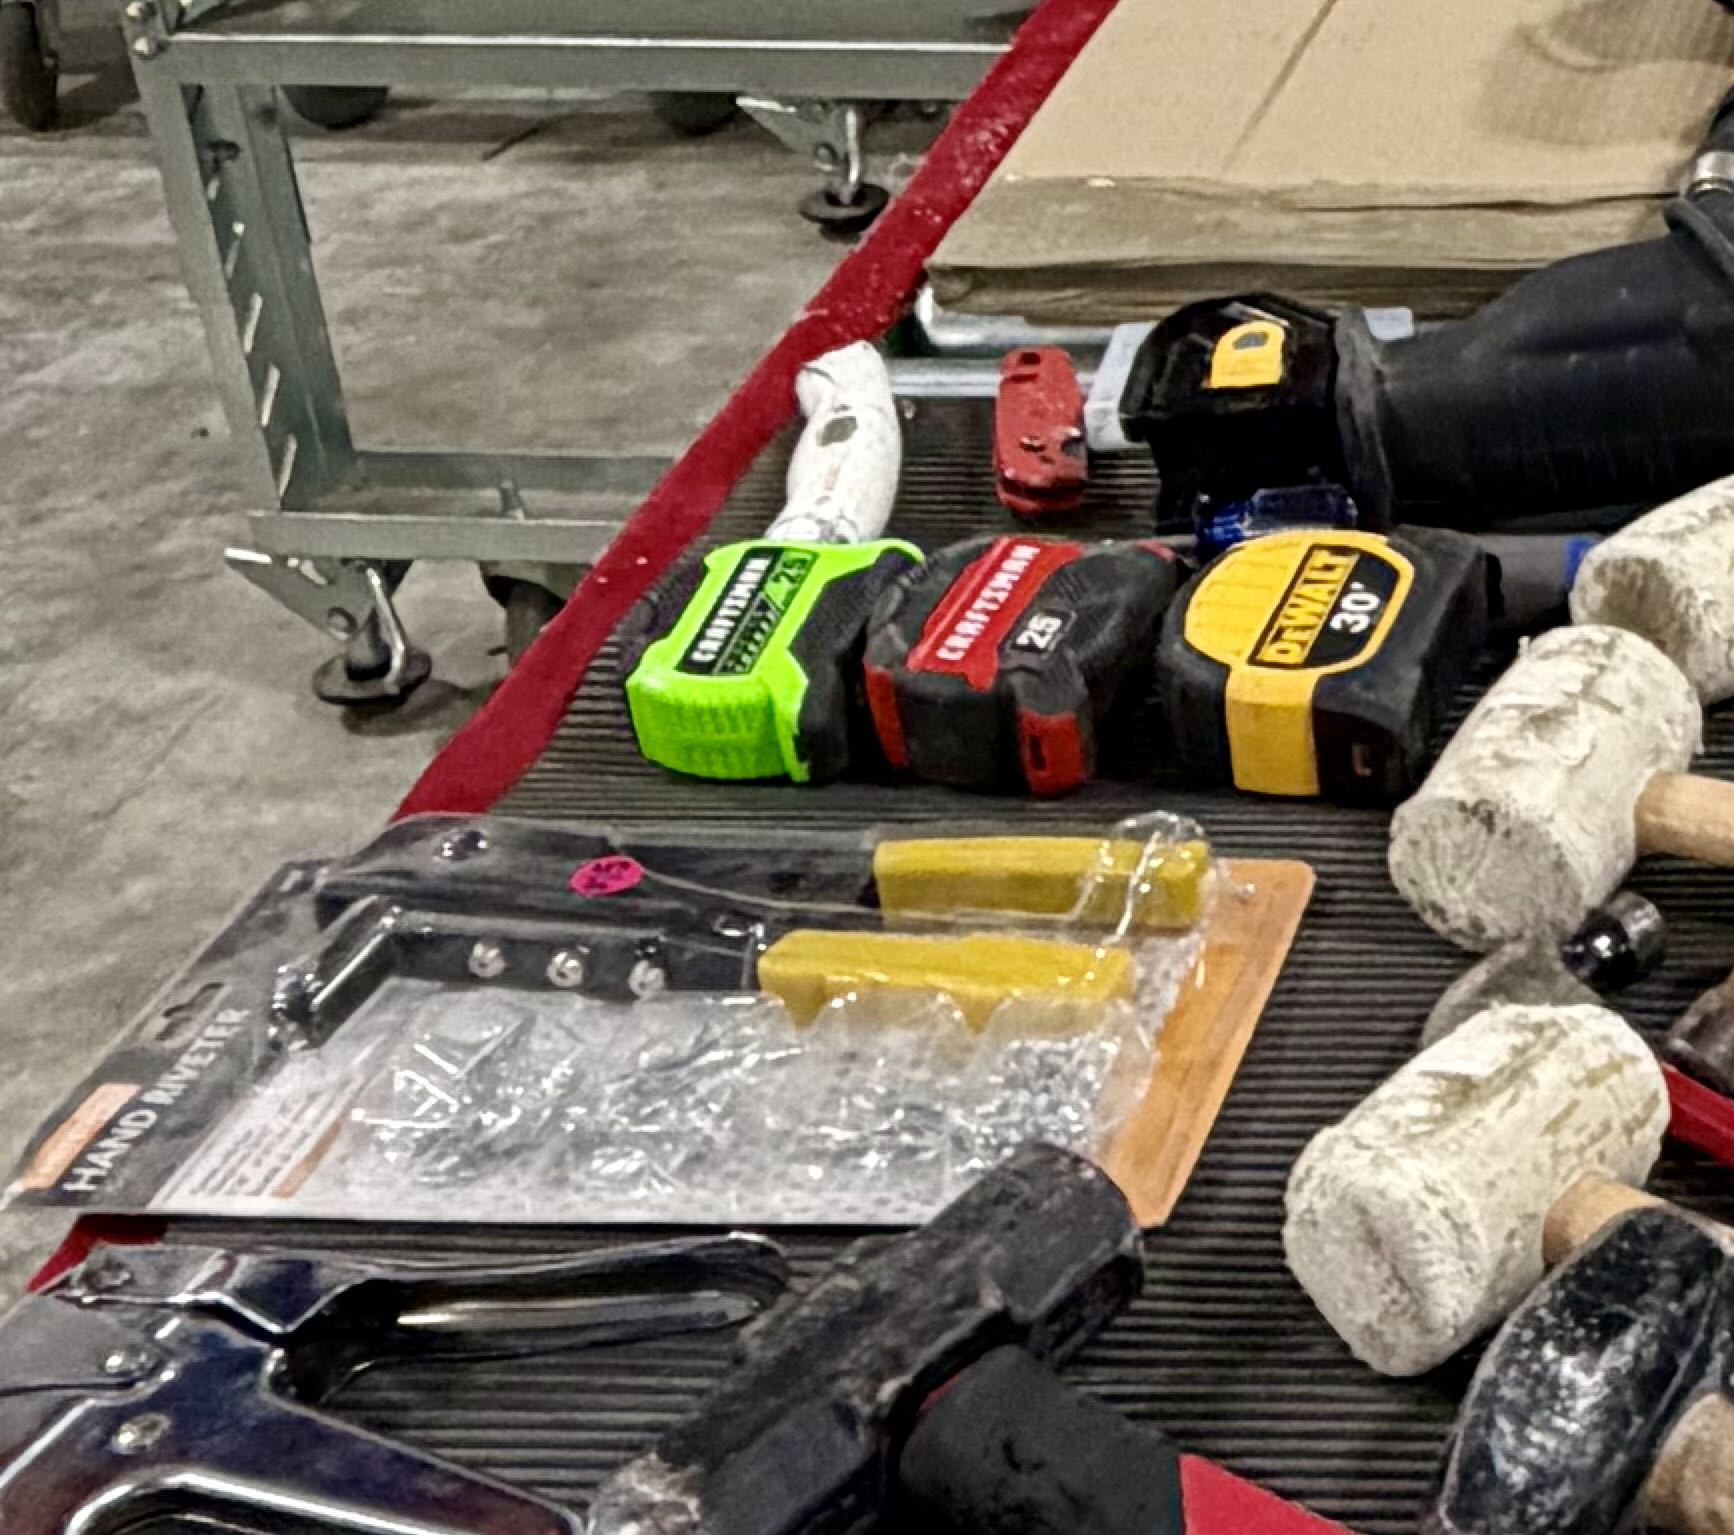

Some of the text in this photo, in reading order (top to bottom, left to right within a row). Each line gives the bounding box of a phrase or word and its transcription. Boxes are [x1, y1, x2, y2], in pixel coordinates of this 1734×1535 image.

[691, 557, 772, 662] CRAFTSMAN
[935, 544, 1041, 661] CRAFTSMAN
[1015, 613, 1063, 649] 25
[1259, 549, 1352, 663] DEWALT
[62, 1109, 157, 1191] HAND
[140, 1007, 250, 1105] RIVETER
